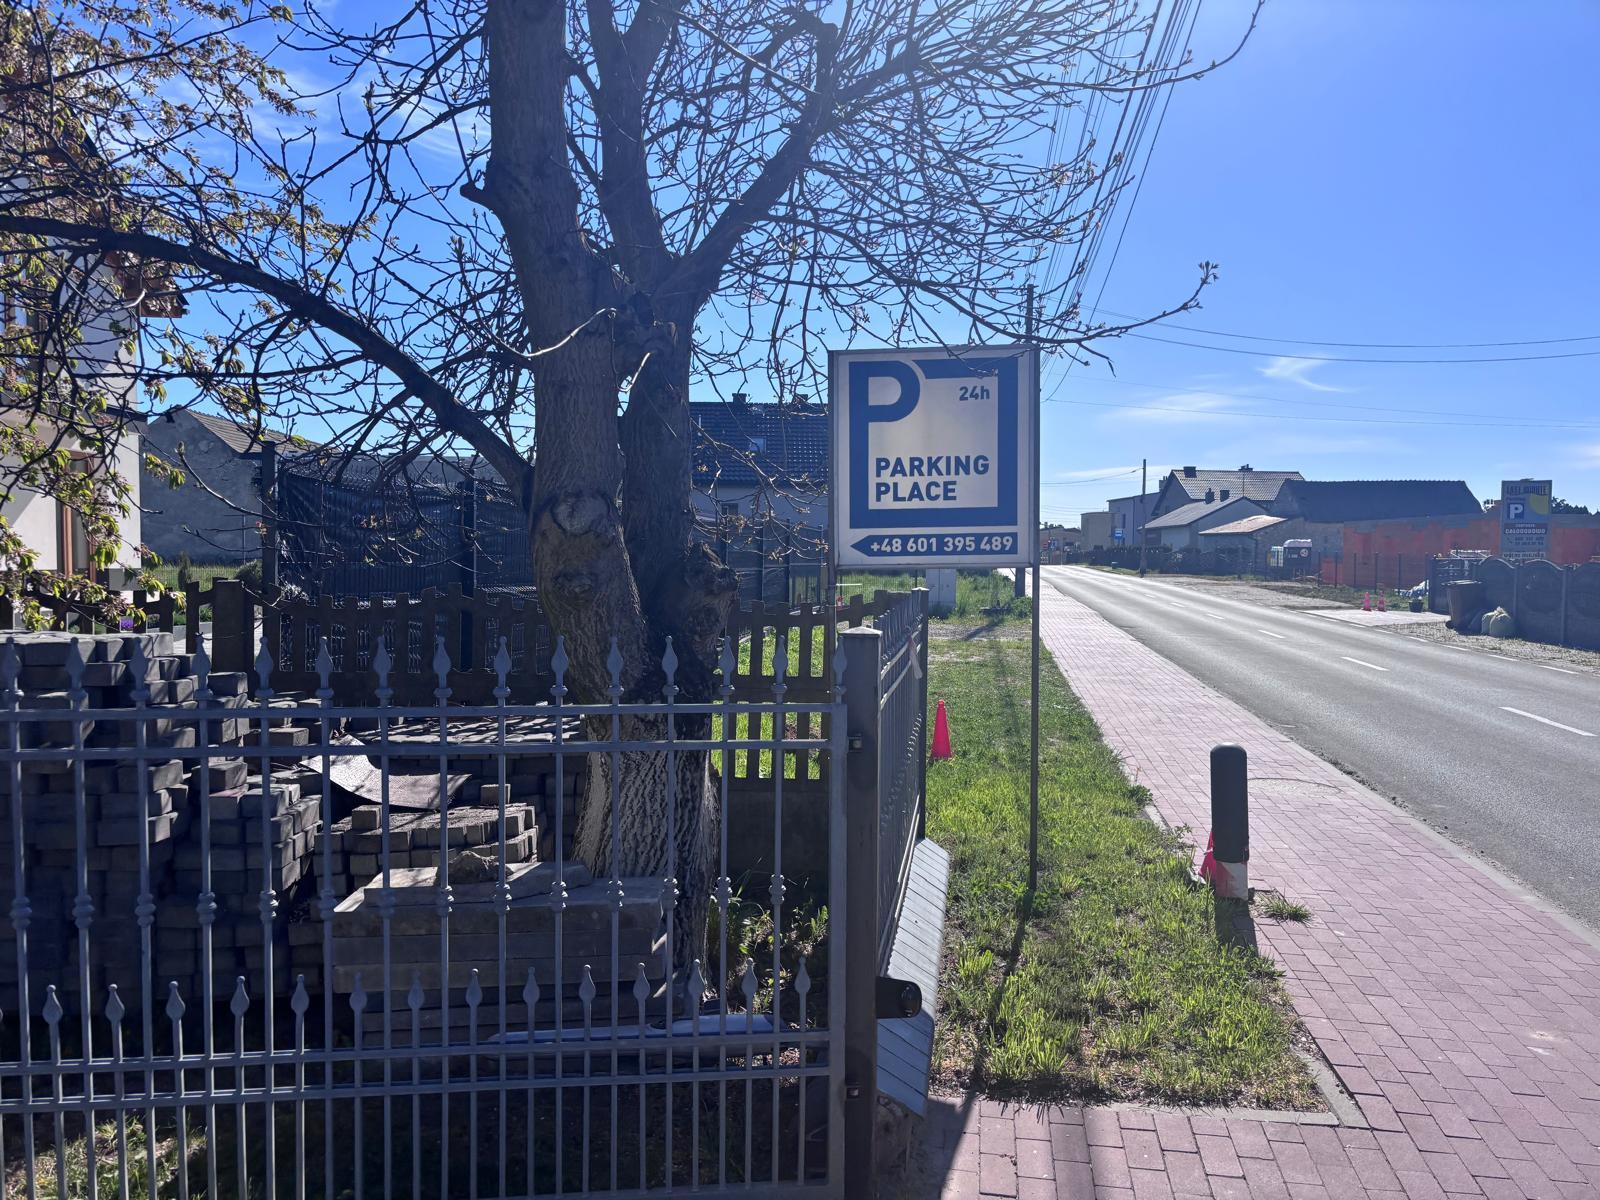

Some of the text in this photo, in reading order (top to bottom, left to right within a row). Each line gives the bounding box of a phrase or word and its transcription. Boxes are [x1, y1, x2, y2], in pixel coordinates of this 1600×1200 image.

[849, 360, 921, 423] P
[959, 386, 990, 401] 24h
[875, 455, 990, 477] PARKING
[875, 481, 957, 502] PLACE
[1509, 504, 1524, 520] P
[871, 535, 1013, 553] +48 601 395 489
